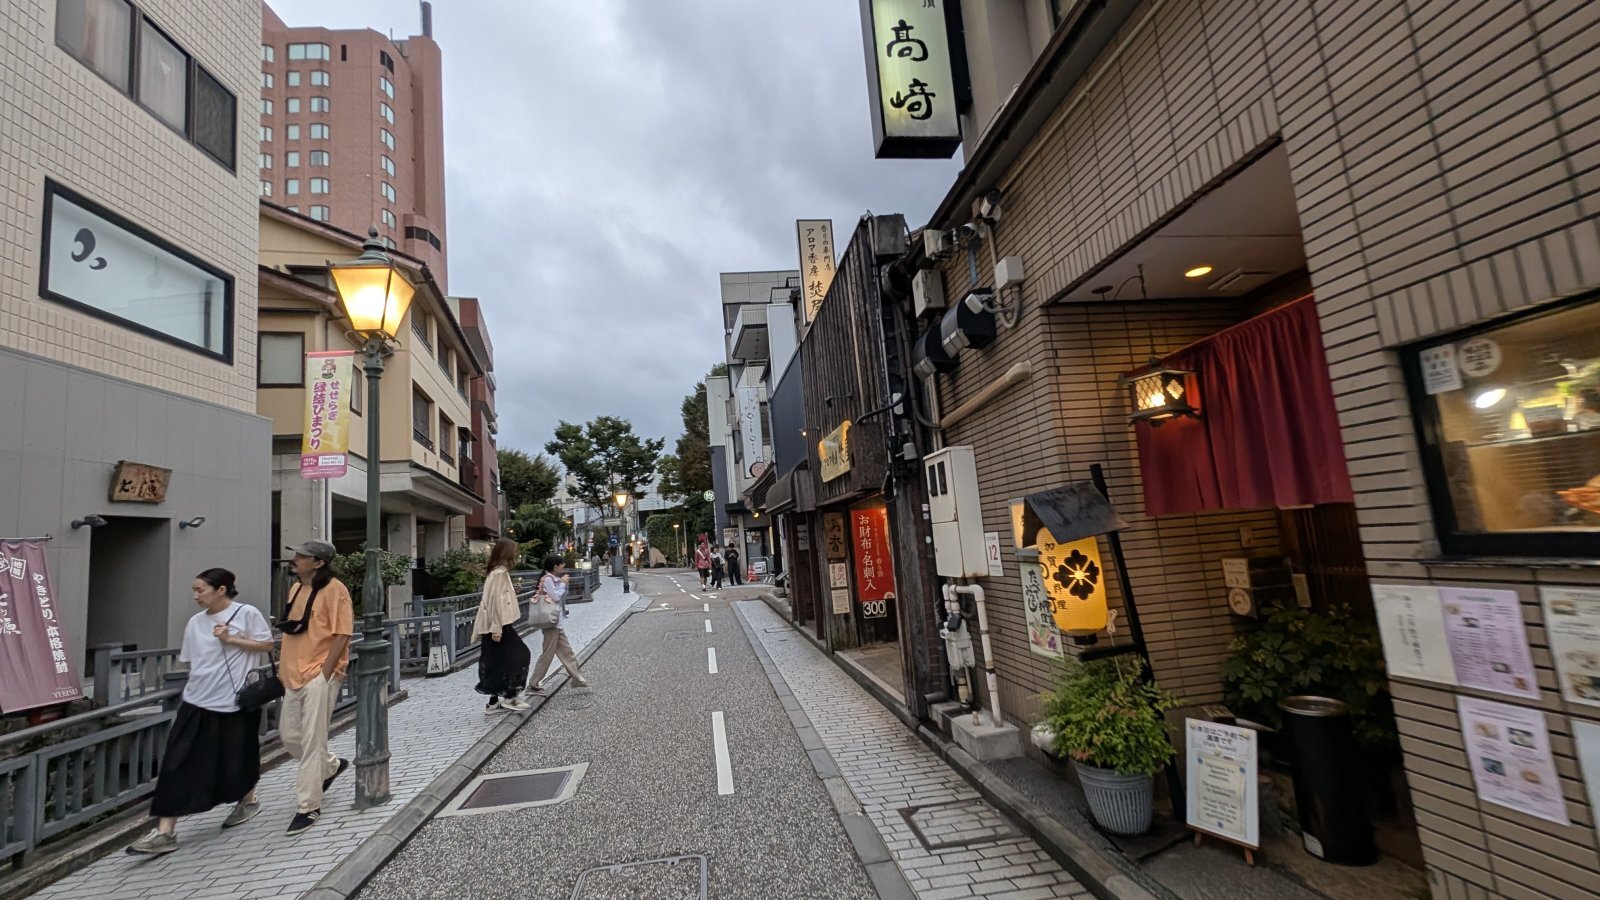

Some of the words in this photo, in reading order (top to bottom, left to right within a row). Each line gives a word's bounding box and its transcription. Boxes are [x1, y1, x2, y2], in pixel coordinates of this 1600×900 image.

[806, 228, 820, 278] アロマ香房
[310, 381, 327, 451] 縁結びまつり
[328, 380, 341, 421] せせらぎ
[858, 514, 877, 591] お財布・名刺入
[32, 572, 69, 674] やきとり、本格焼酎
[864, 602, 885, 615] 300
[53, 688, 78, 698] YEBISU
